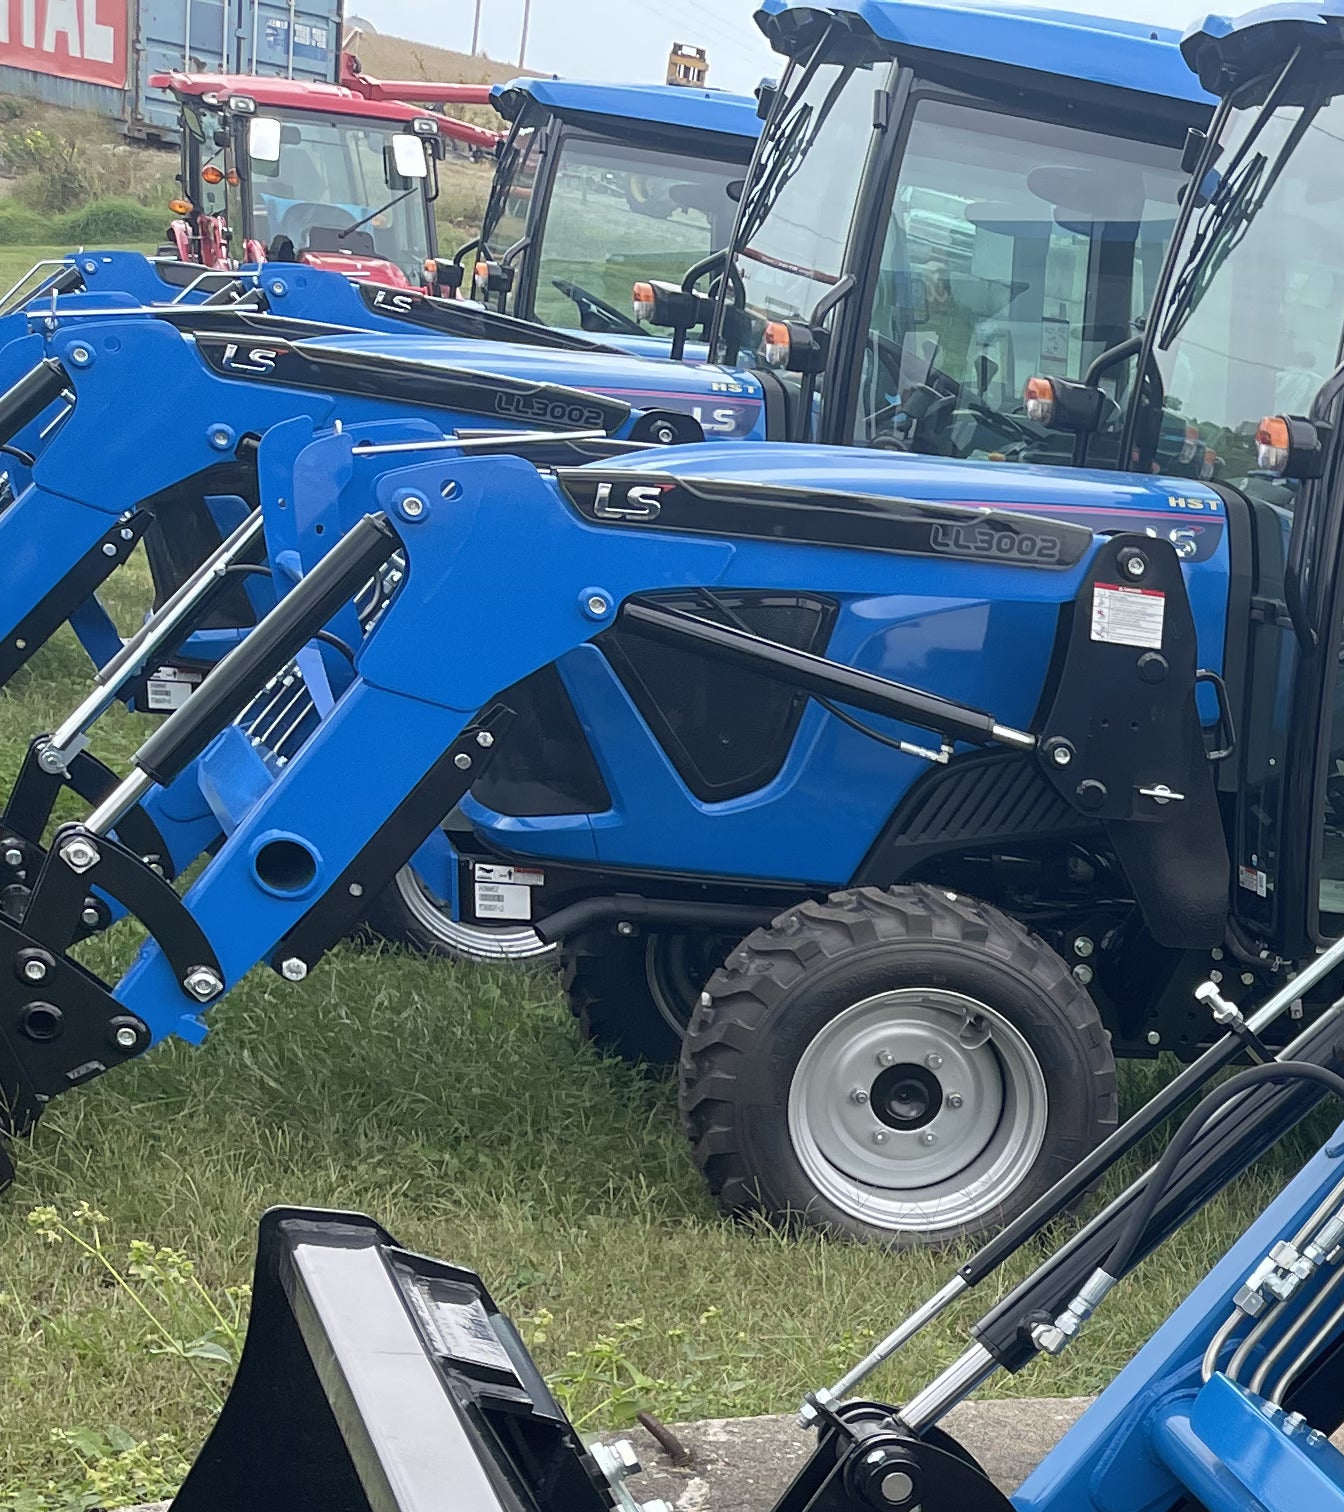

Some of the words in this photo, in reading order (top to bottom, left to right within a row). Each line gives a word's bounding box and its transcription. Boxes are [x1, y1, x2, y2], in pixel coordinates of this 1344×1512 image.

[374, 290, 412, 313] LS
[222, 342, 279, 372] LS
[711, 381, 755, 395] HST
[494, 393, 604, 428] LL3002
[594, 482, 661, 520] LS
[1168, 496, 1222, 511] HST
[930, 523, 1060, 562] LL3002
